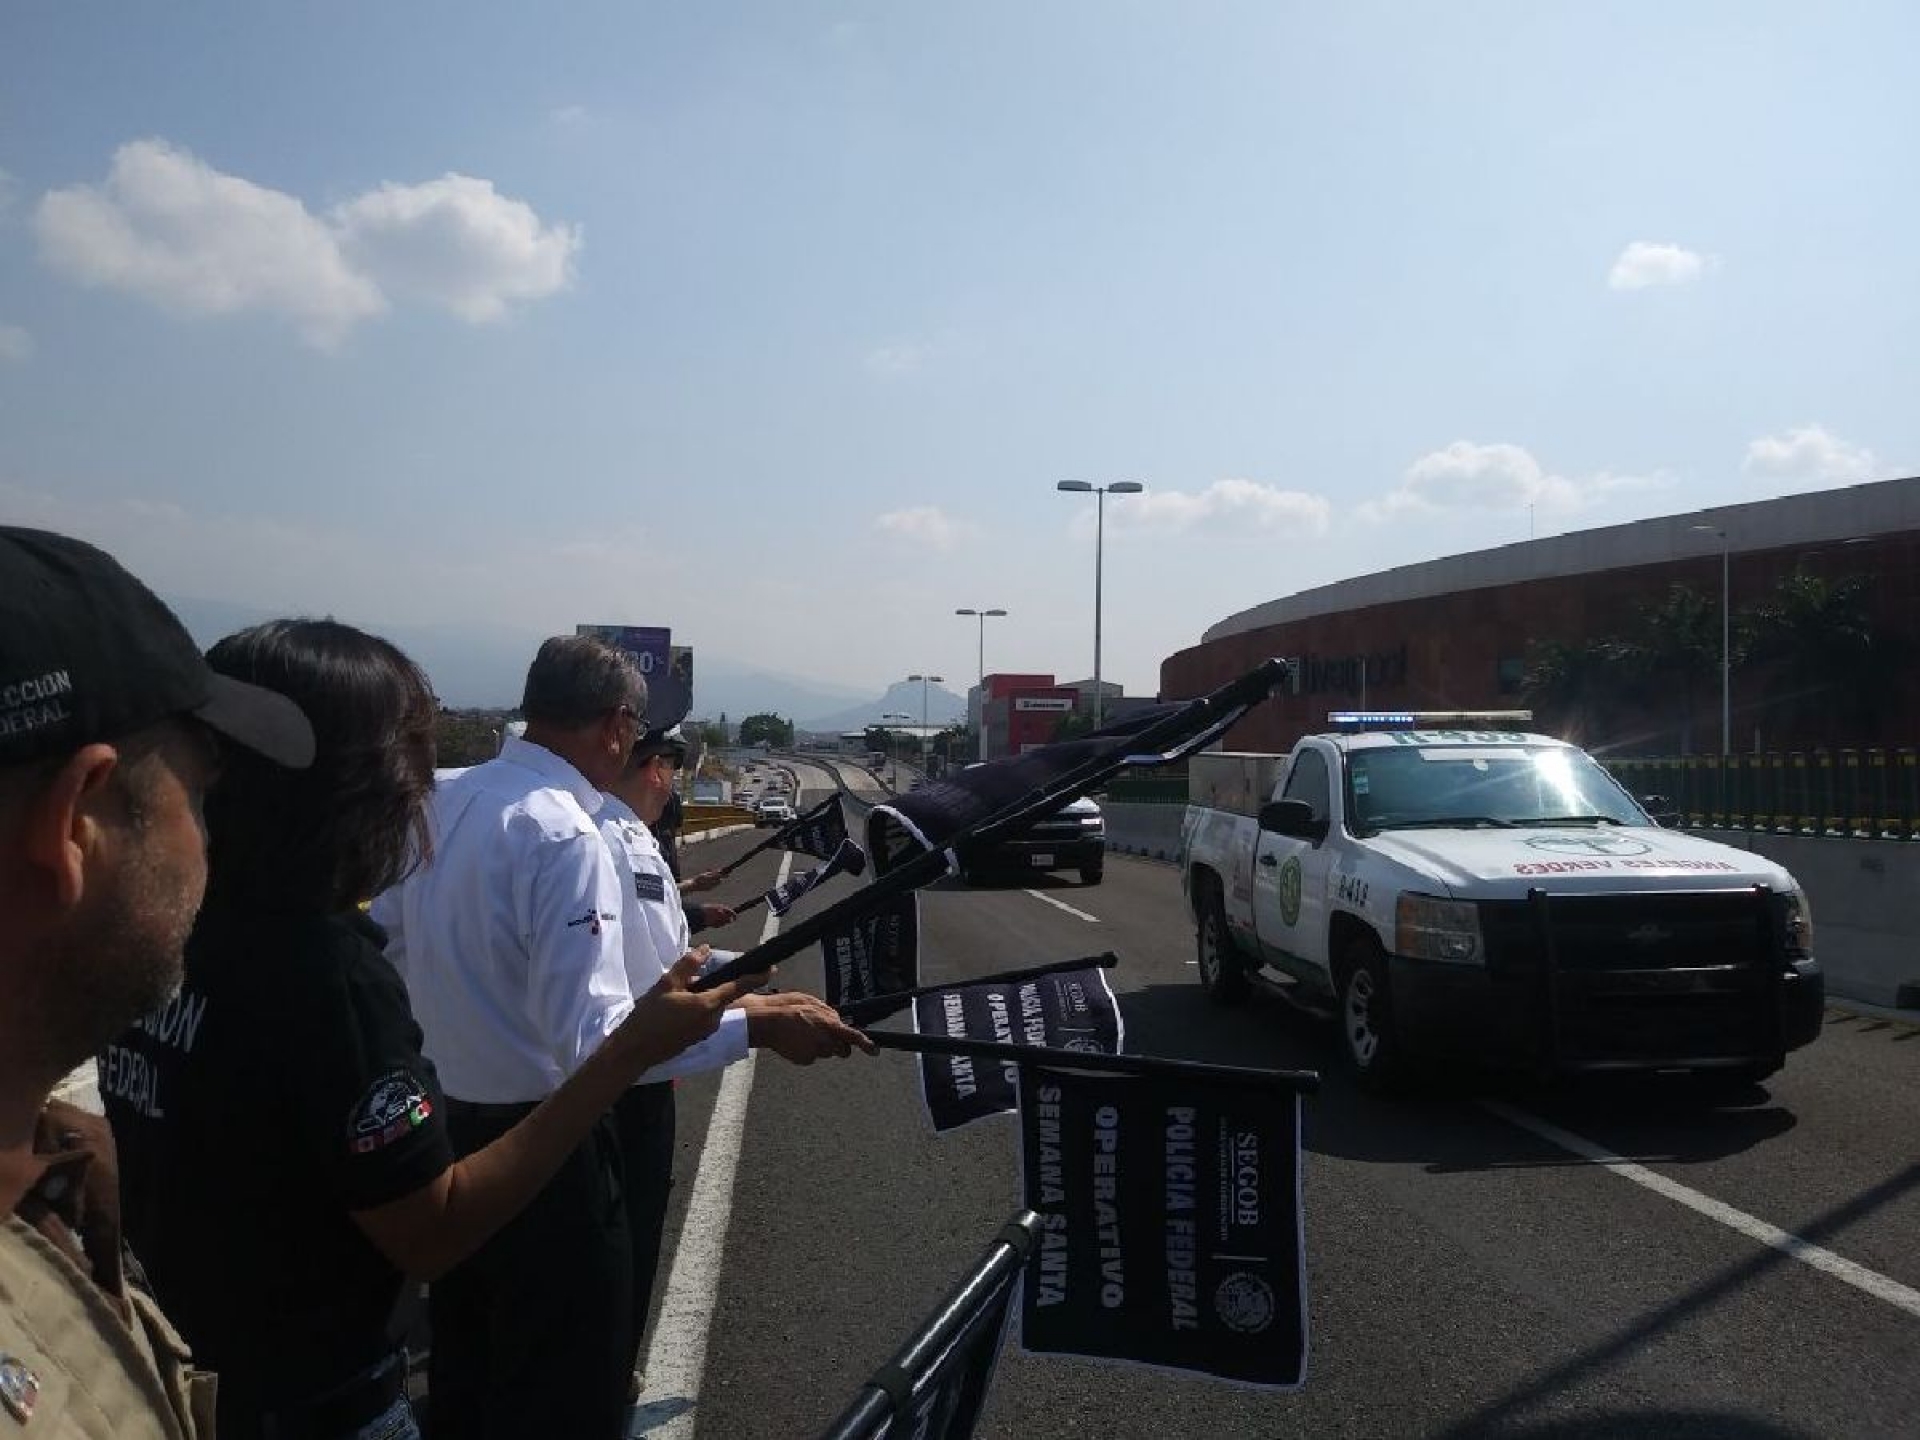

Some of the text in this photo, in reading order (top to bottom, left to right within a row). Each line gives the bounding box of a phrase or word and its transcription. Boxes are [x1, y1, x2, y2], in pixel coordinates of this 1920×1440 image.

[2, 669, 72, 707] CCION
[1036, 1087, 1068, 1308] SEMANA SANTA
[1093, 1106, 1124, 1308] OPERATIVO
[1165, 1106, 1200, 1331] POLICIA FEDERAL
[1237, 1132, 1259, 1225] SEGOB
